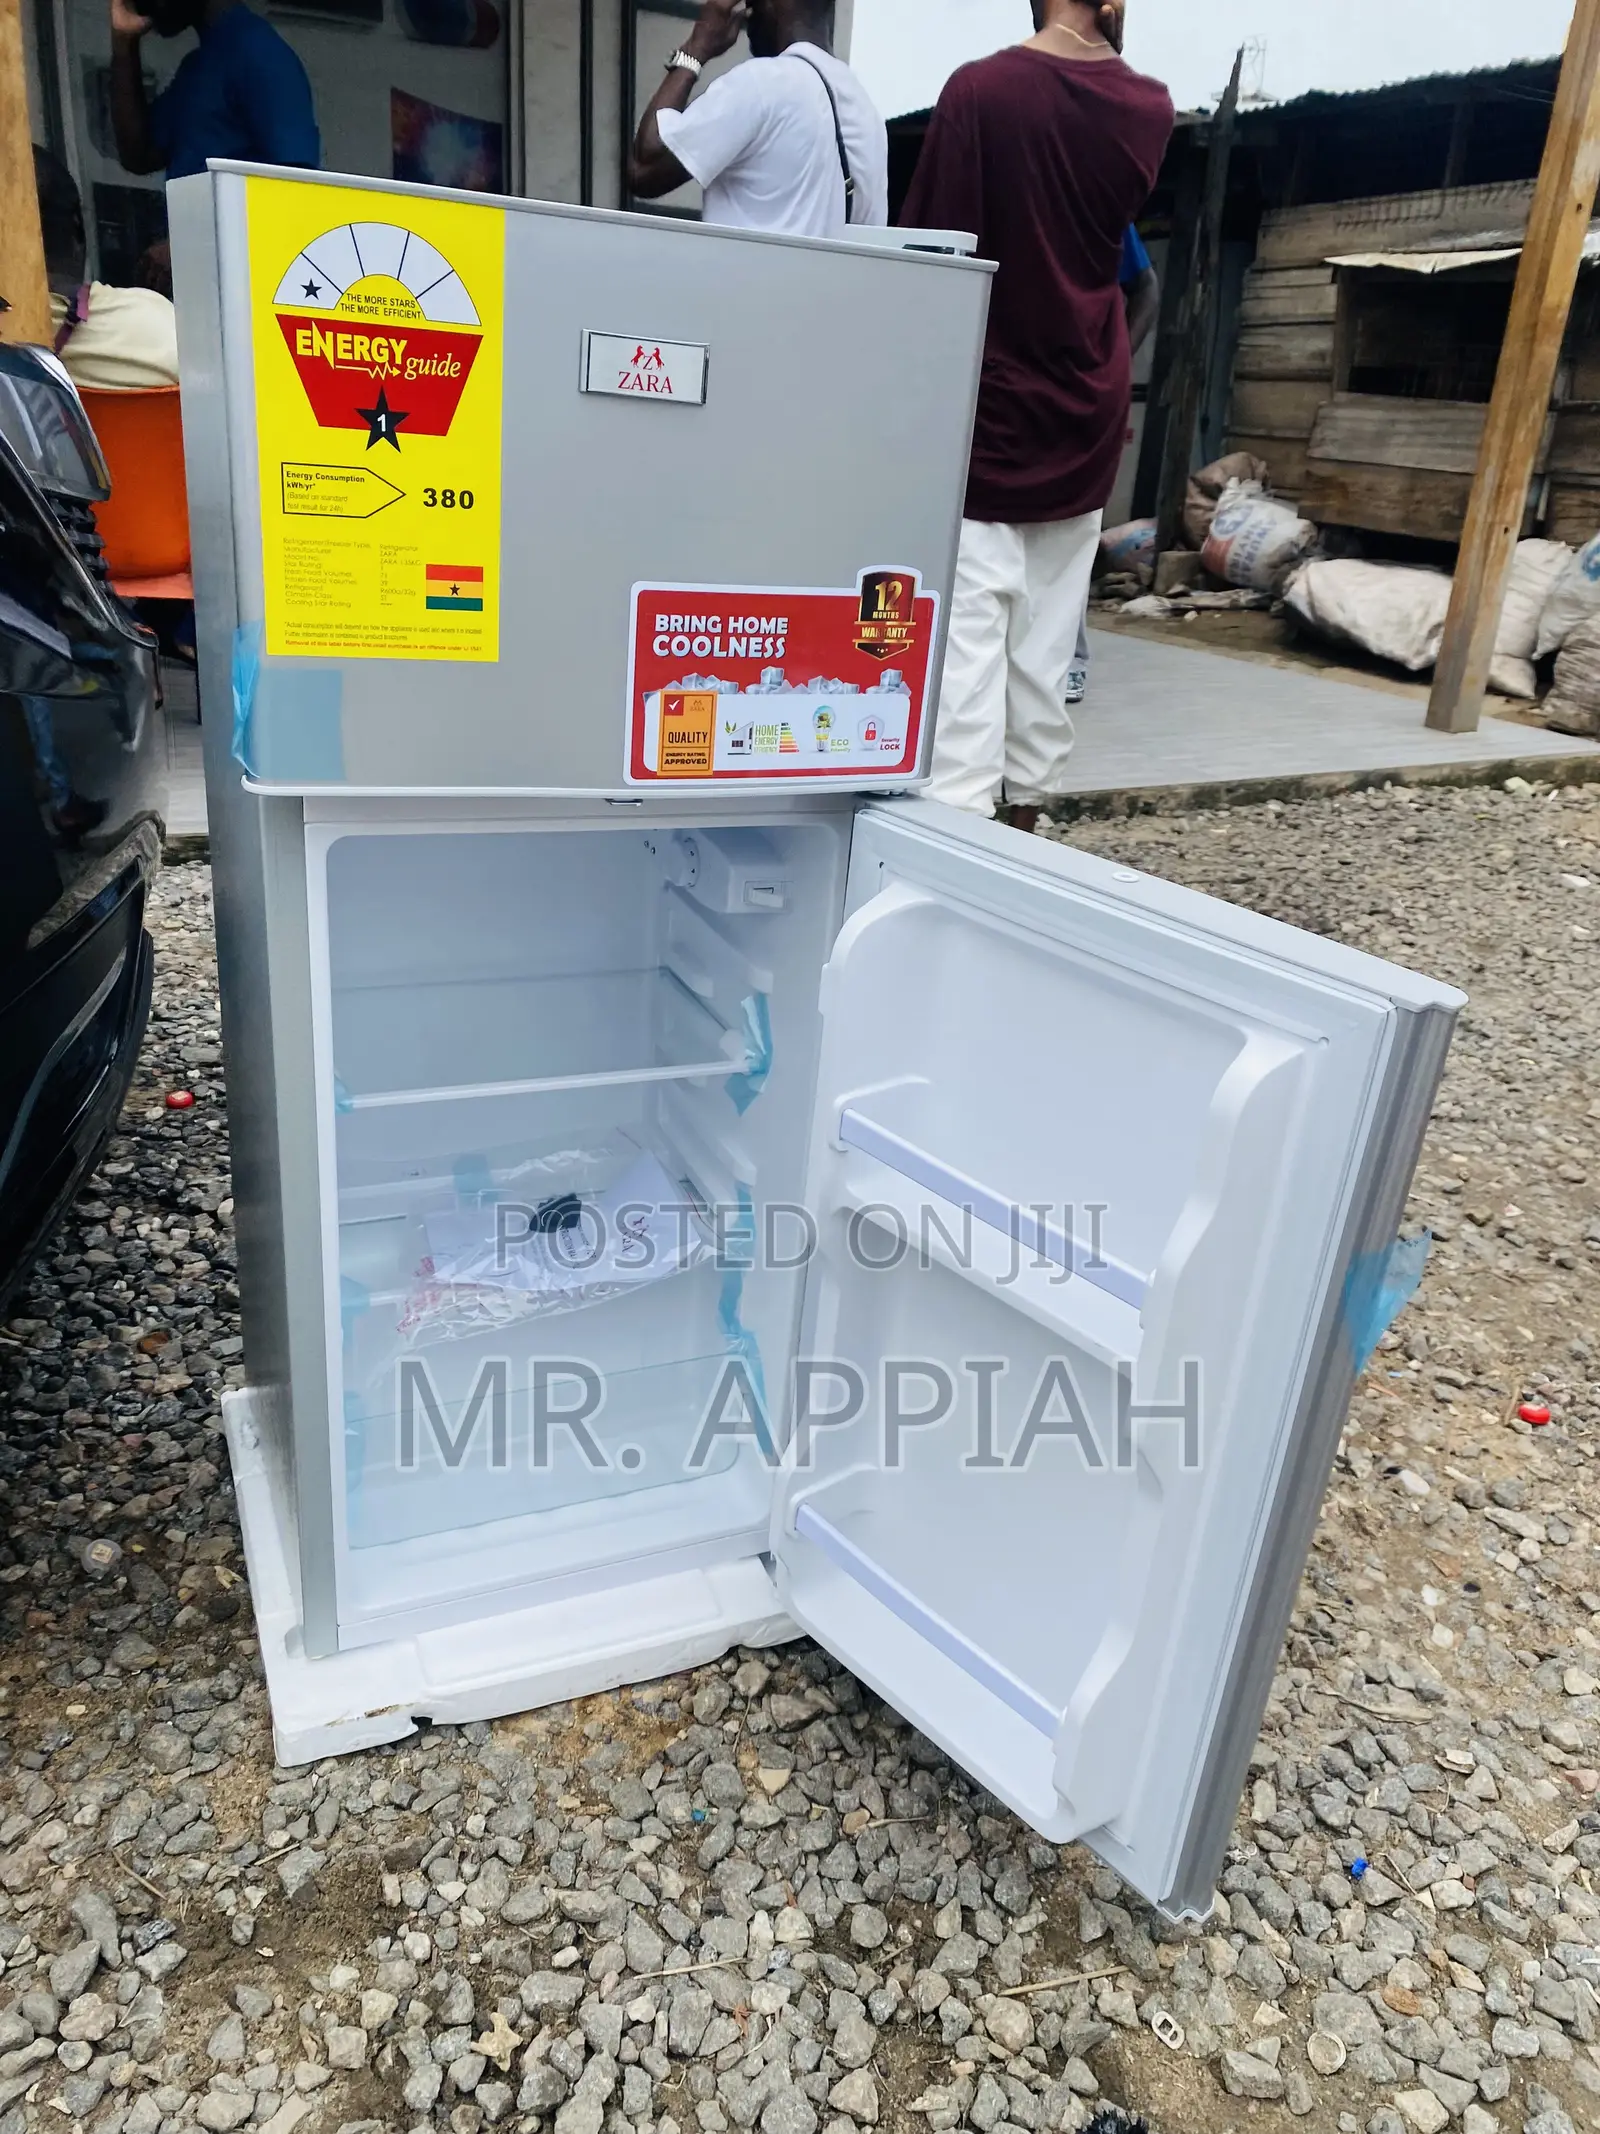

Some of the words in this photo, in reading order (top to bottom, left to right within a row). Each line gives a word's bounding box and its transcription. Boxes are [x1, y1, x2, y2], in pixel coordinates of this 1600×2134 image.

[346, 292, 363, 304] THE
[364, 295, 388, 306] MORE
[389, 297, 416, 309] STARS
[340, 302, 356, 313] THE
[357, 304, 380, 316] MORE
[383, 307, 422, 320] EFFICIENT
[296, 320, 408, 370] ENERGY
[404, 353, 461, 381] guide
[617, 371, 674, 394] ZARA
[376, 413, 387, 432] 1
[286, 471, 313, 481] Energy
[315, 473, 365, 483] Consumption
[422, 487, 474, 510] 380
[875, 580, 903, 611] 12
[654, 613, 722, 634] BRING
[727, 616, 789, 635] HOME
[861, 627, 908, 638] WARANTY
[652, 635, 786, 659] COOLNESS
[668, 731, 709, 744] QUALITY
[755, 723, 780, 736] HOME
[754, 736, 778, 745] ENERGY
[880, 743, 901, 751] LOCK
